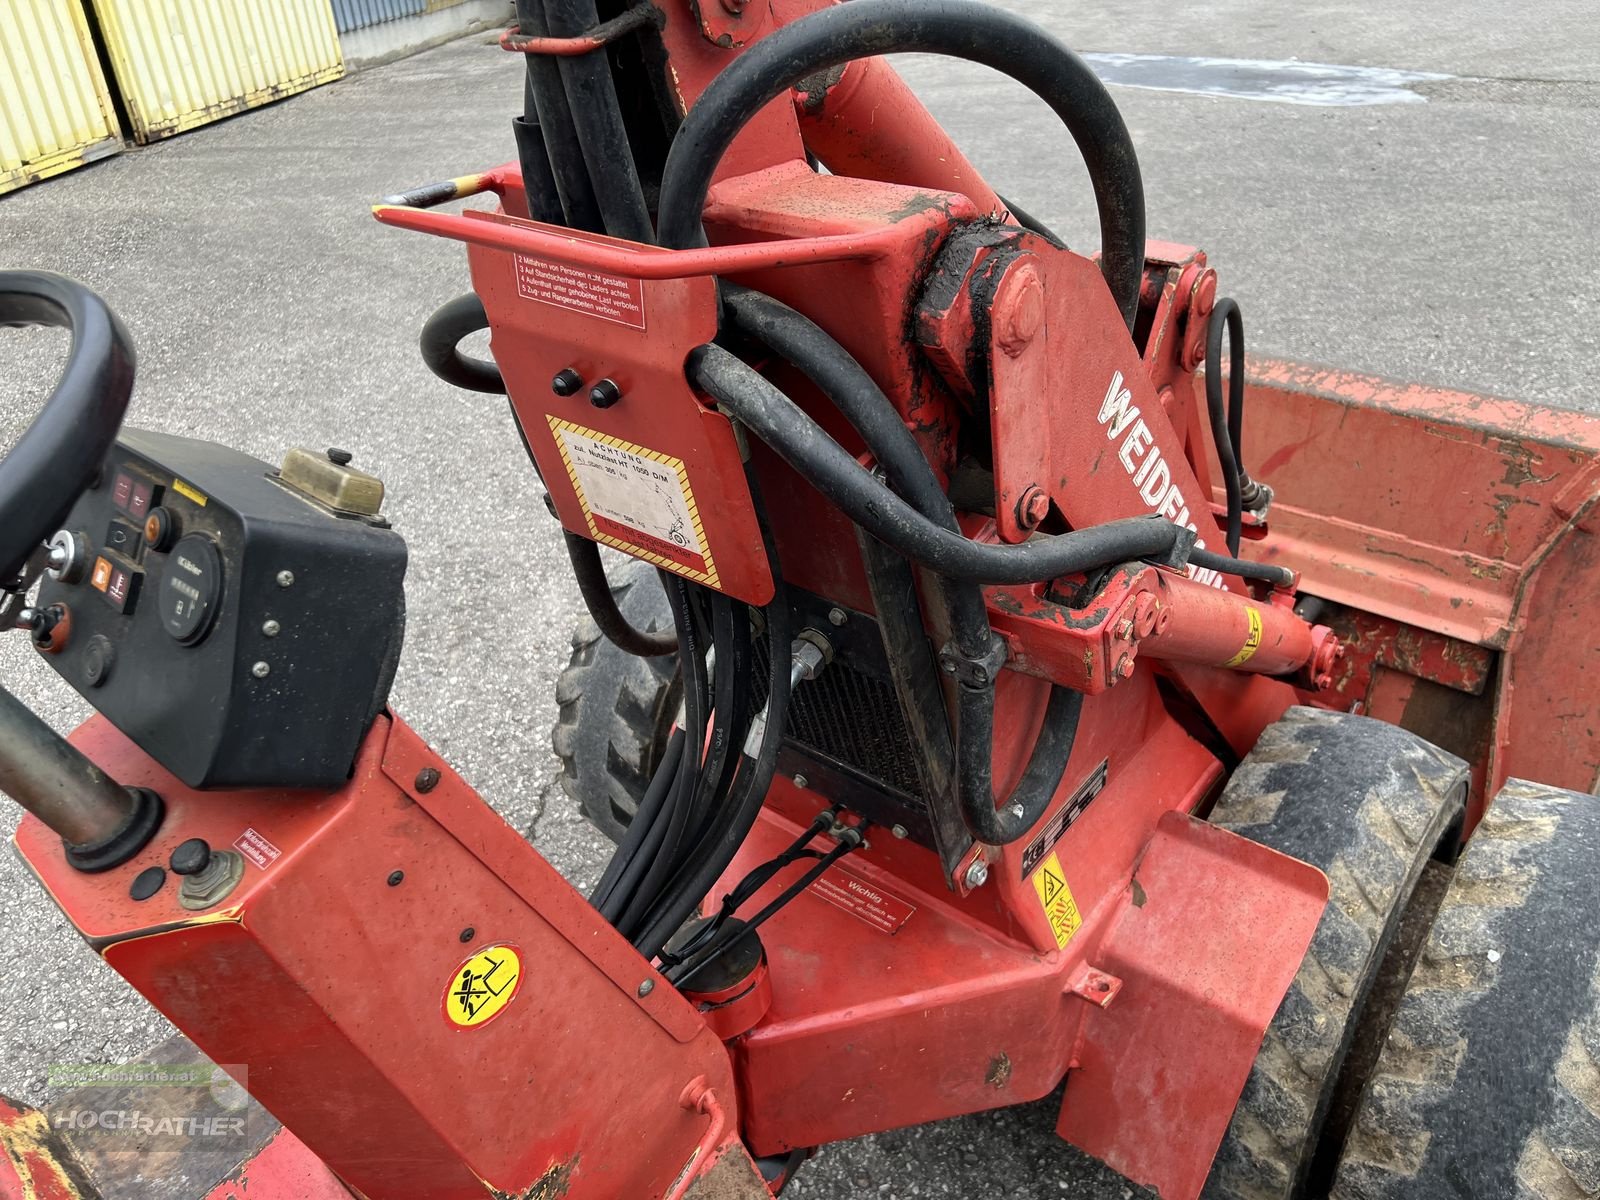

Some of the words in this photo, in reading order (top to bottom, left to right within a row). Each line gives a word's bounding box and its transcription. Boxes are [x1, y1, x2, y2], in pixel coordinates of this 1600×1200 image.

[518, 255, 523, 263] 2
[548, 263, 559, 272] von
[560, 265, 586, 278] Personen
[519, 265, 524, 273] 3
[525, 266, 534, 275] Auf
[589, 282, 609, 294] Laders
[520, 275, 525, 283] 4
[553, 283, 567, 293] unter
[599, 295, 612, 305] Last
[540, 290, 551, 298] und
[588, 448, 617, 464] Nutzlast
[618, 459, 628, 469] HT
[632, 464, 649, 476] 1050
[652, 471, 669, 483] D/M
[593, 442, 642, 465] ACHTUNG
[603, 518, 620, 530] Nur
[638, 532, 692, 559] abgesenkter
[847, 880, 882, 904] Wichtig
